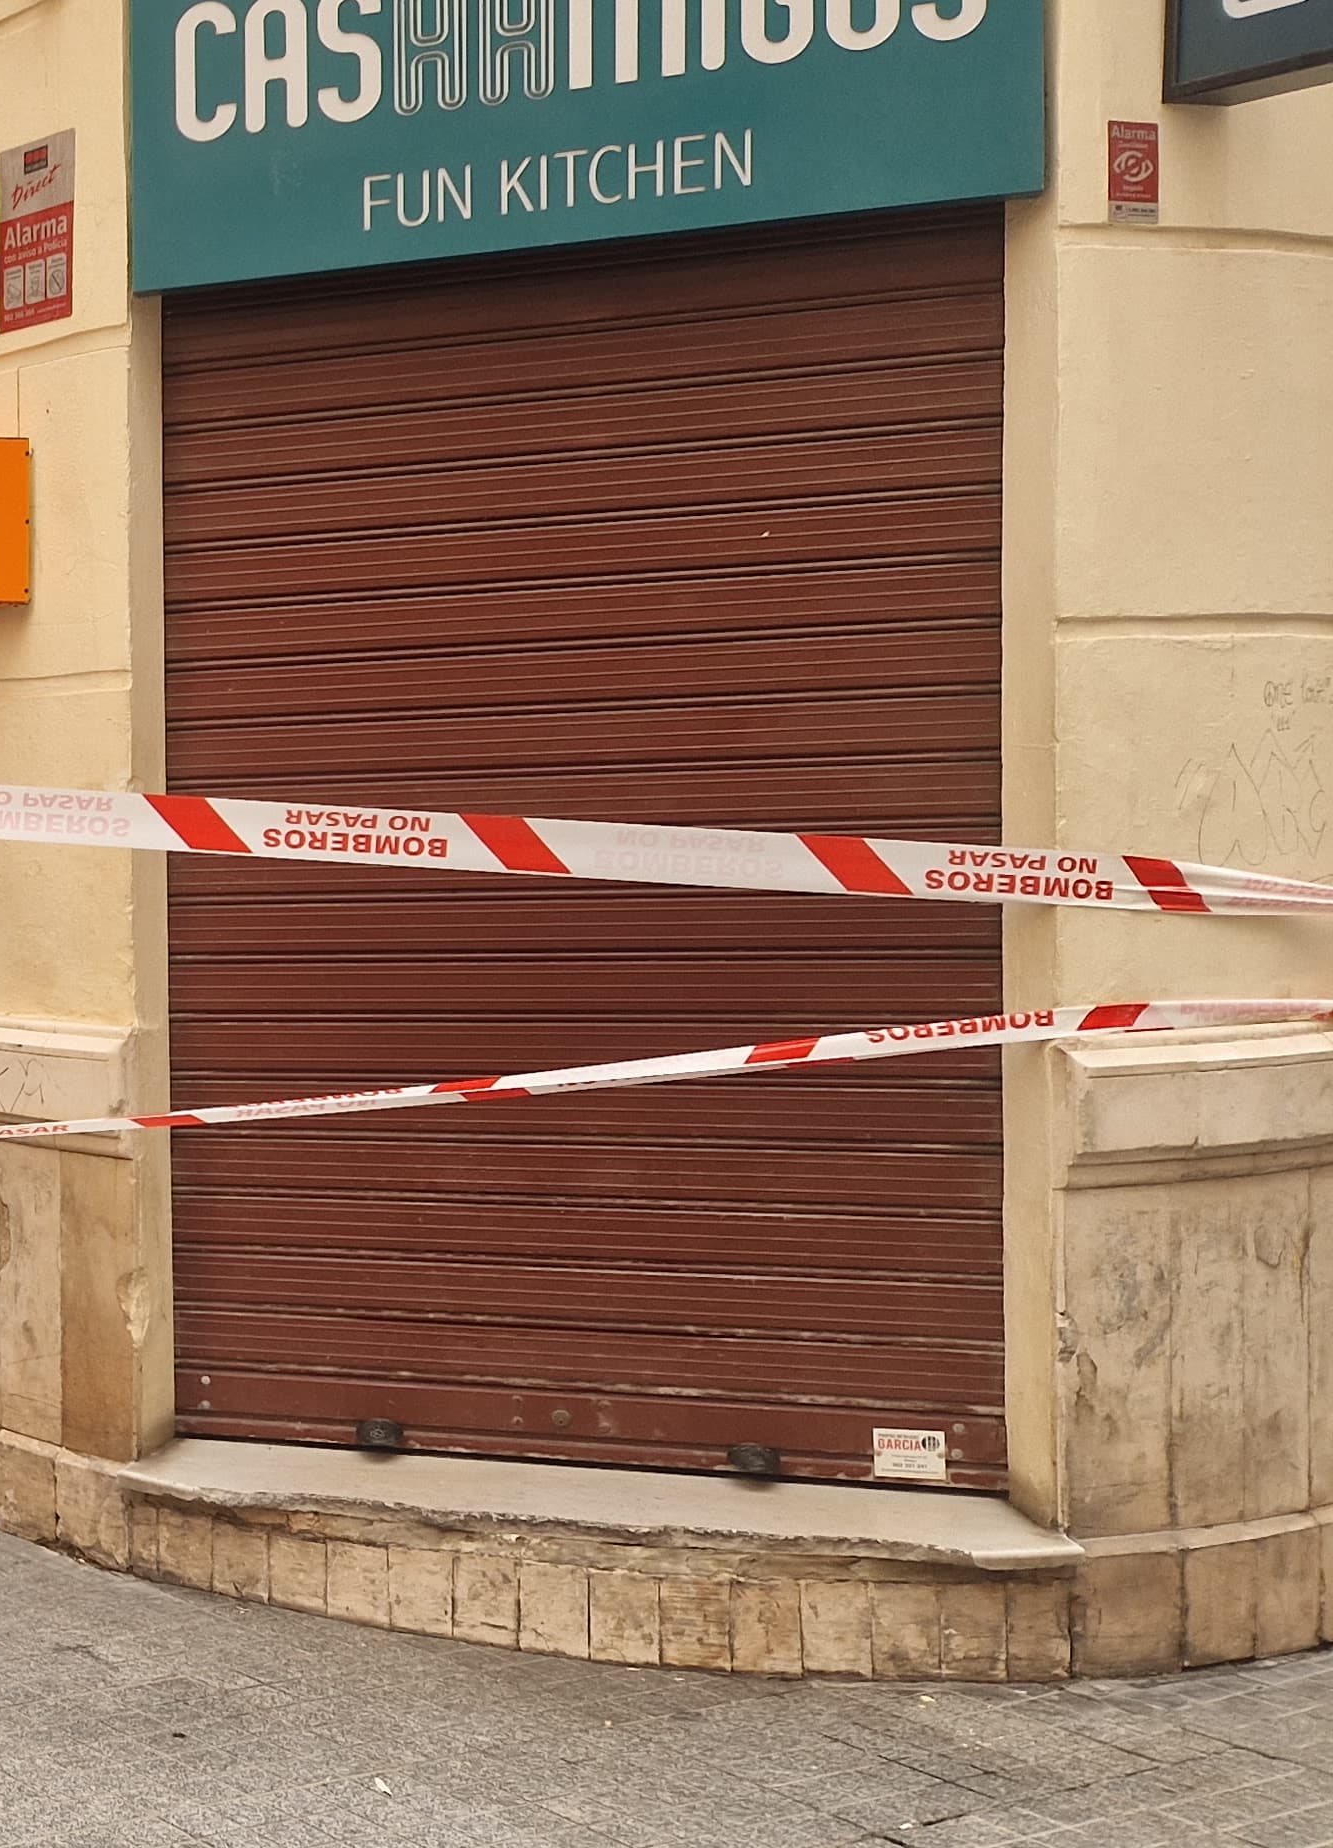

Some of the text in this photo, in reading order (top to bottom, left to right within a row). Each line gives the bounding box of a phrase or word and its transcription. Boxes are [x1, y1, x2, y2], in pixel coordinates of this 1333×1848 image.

[1111, 124, 1157, 140] Alarma
[12, 164, 61, 211] Direct
[363, 128, 753, 231] FUN KITCHEN
[4, 215, 68, 250] Alarma
[285, 809, 431, 832] NO PASAR
[263, 828, 448, 858] BOMBEROS
[948, 849, 1098, 874] NO PASAR
[924, 869, 1114, 901] BOMBEROS
[877, 1438, 921, 1452] GARCIA
